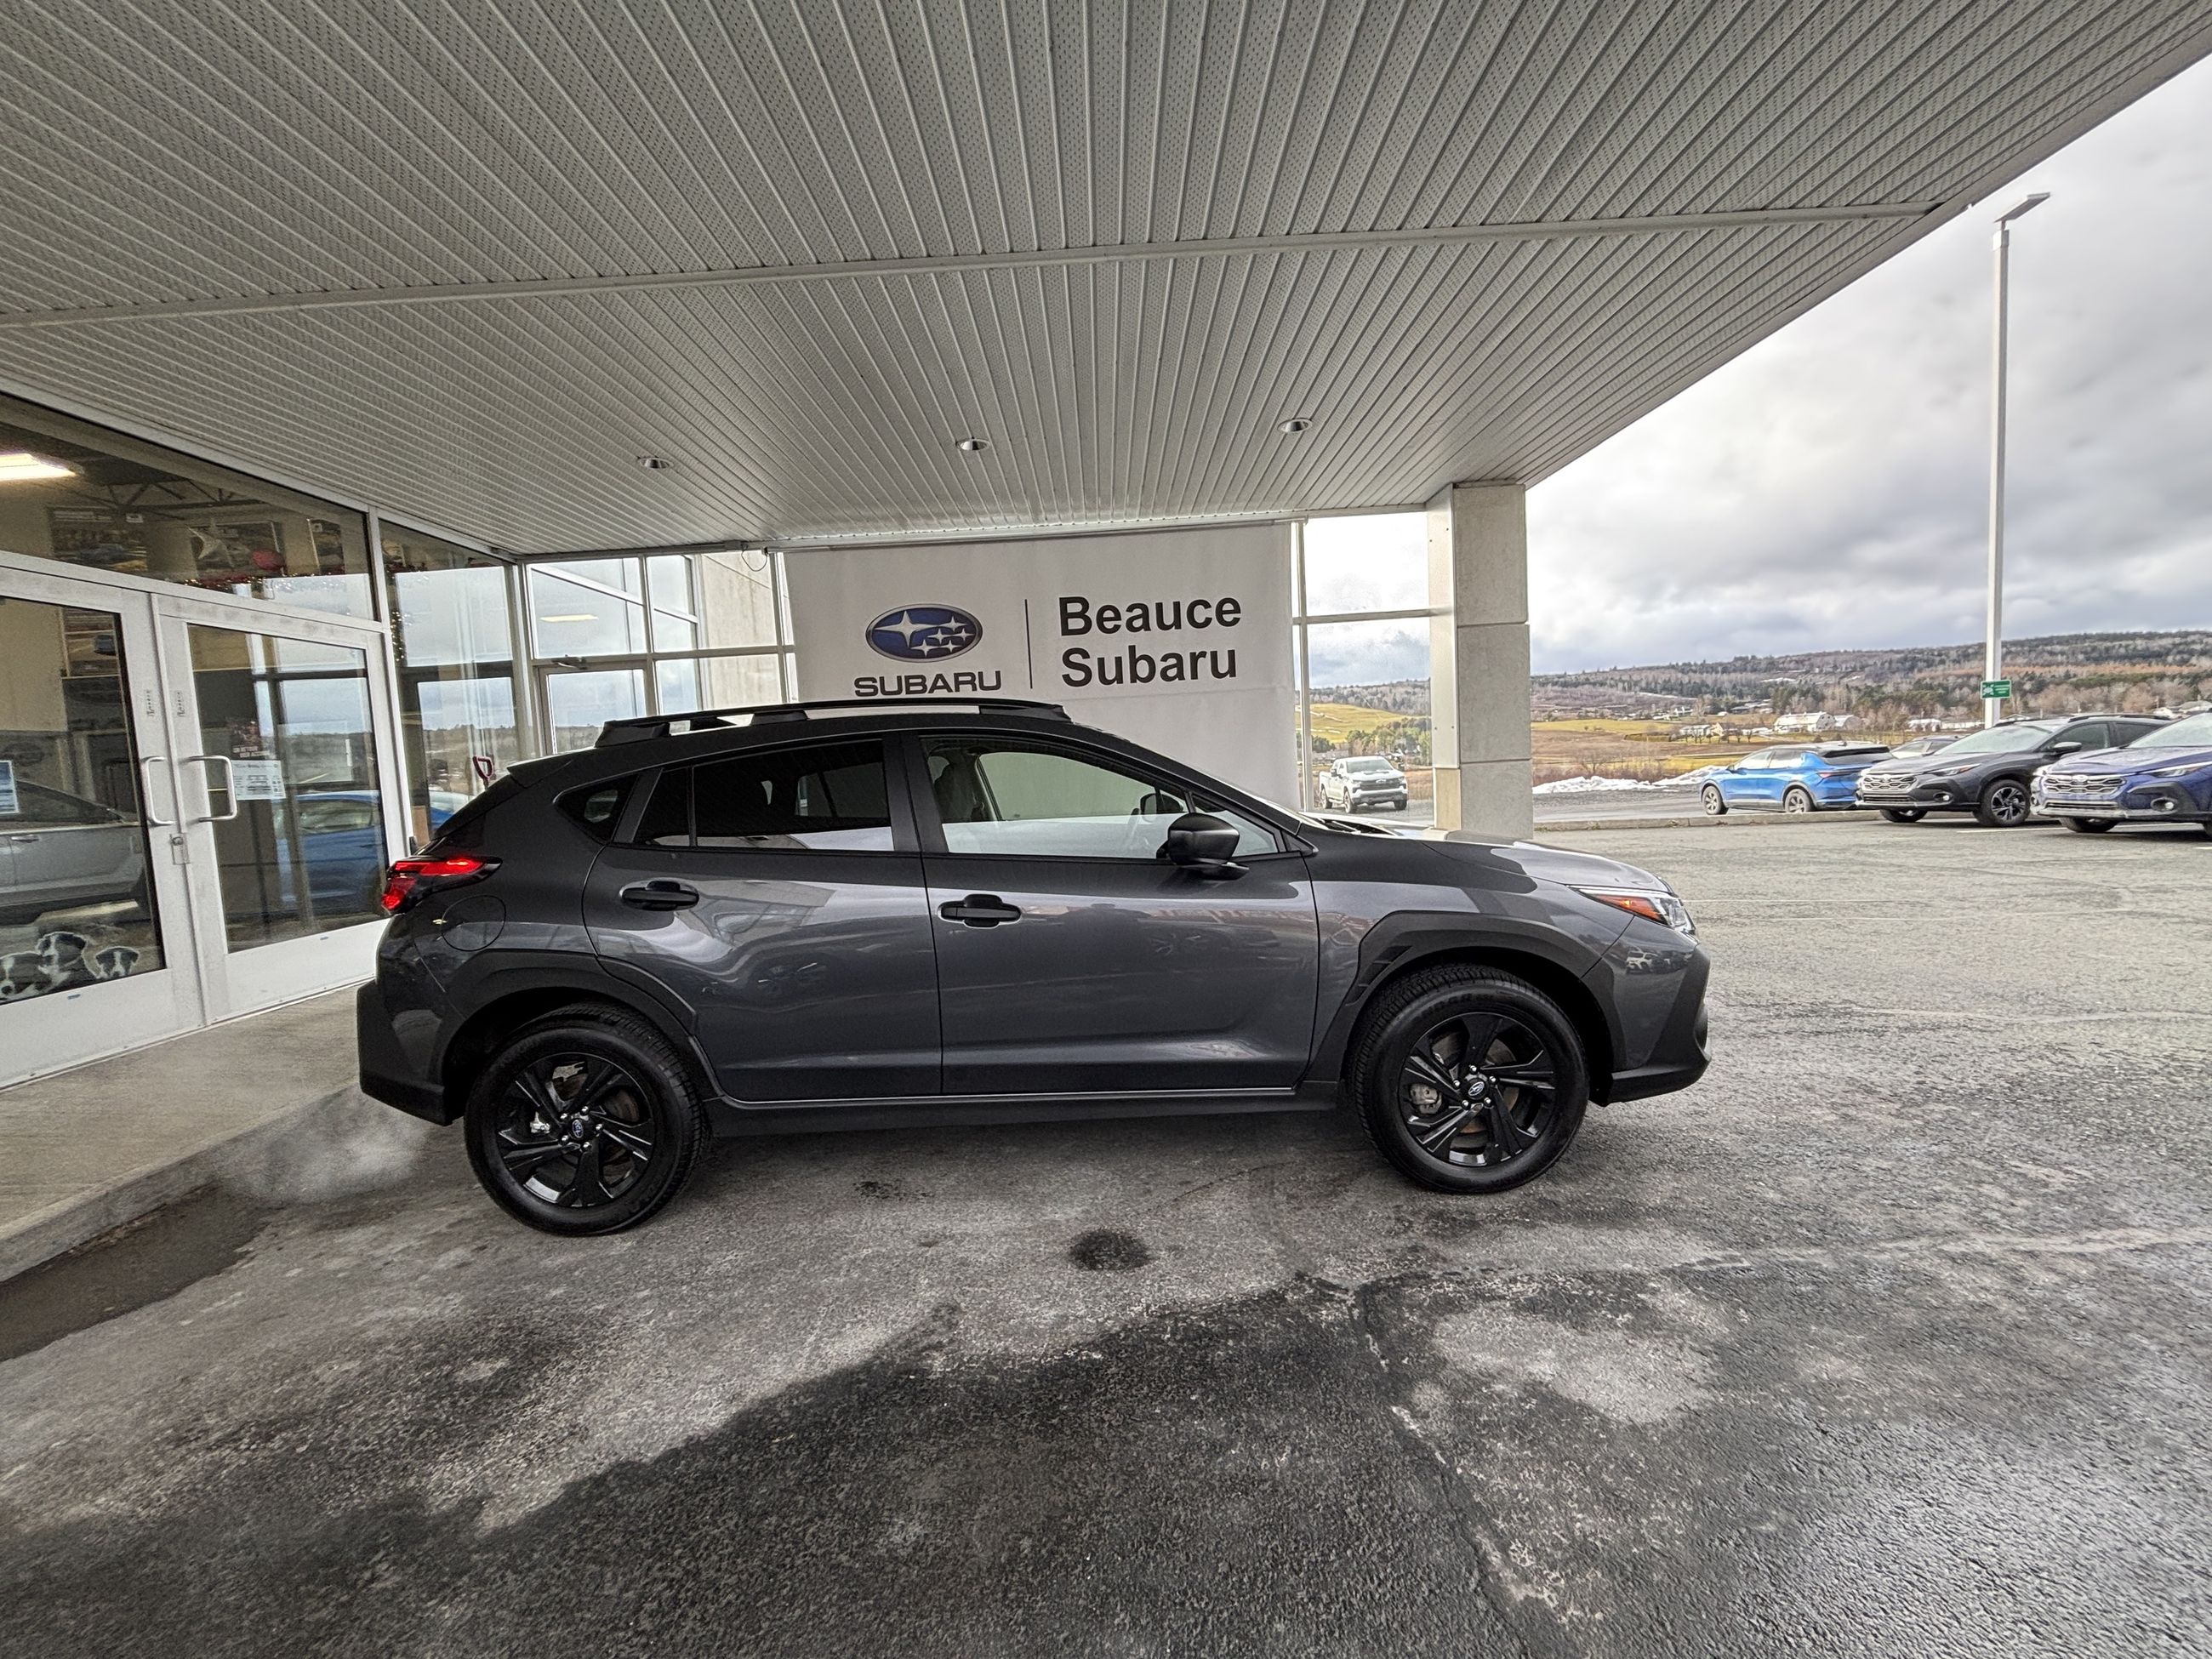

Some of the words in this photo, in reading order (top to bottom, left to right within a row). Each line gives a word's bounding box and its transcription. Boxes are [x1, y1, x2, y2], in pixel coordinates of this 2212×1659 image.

[1058, 596, 1241, 636] Beauce
[852, 670, 1002, 697] SUBARU
[1061, 644, 1236, 687] Subaru
